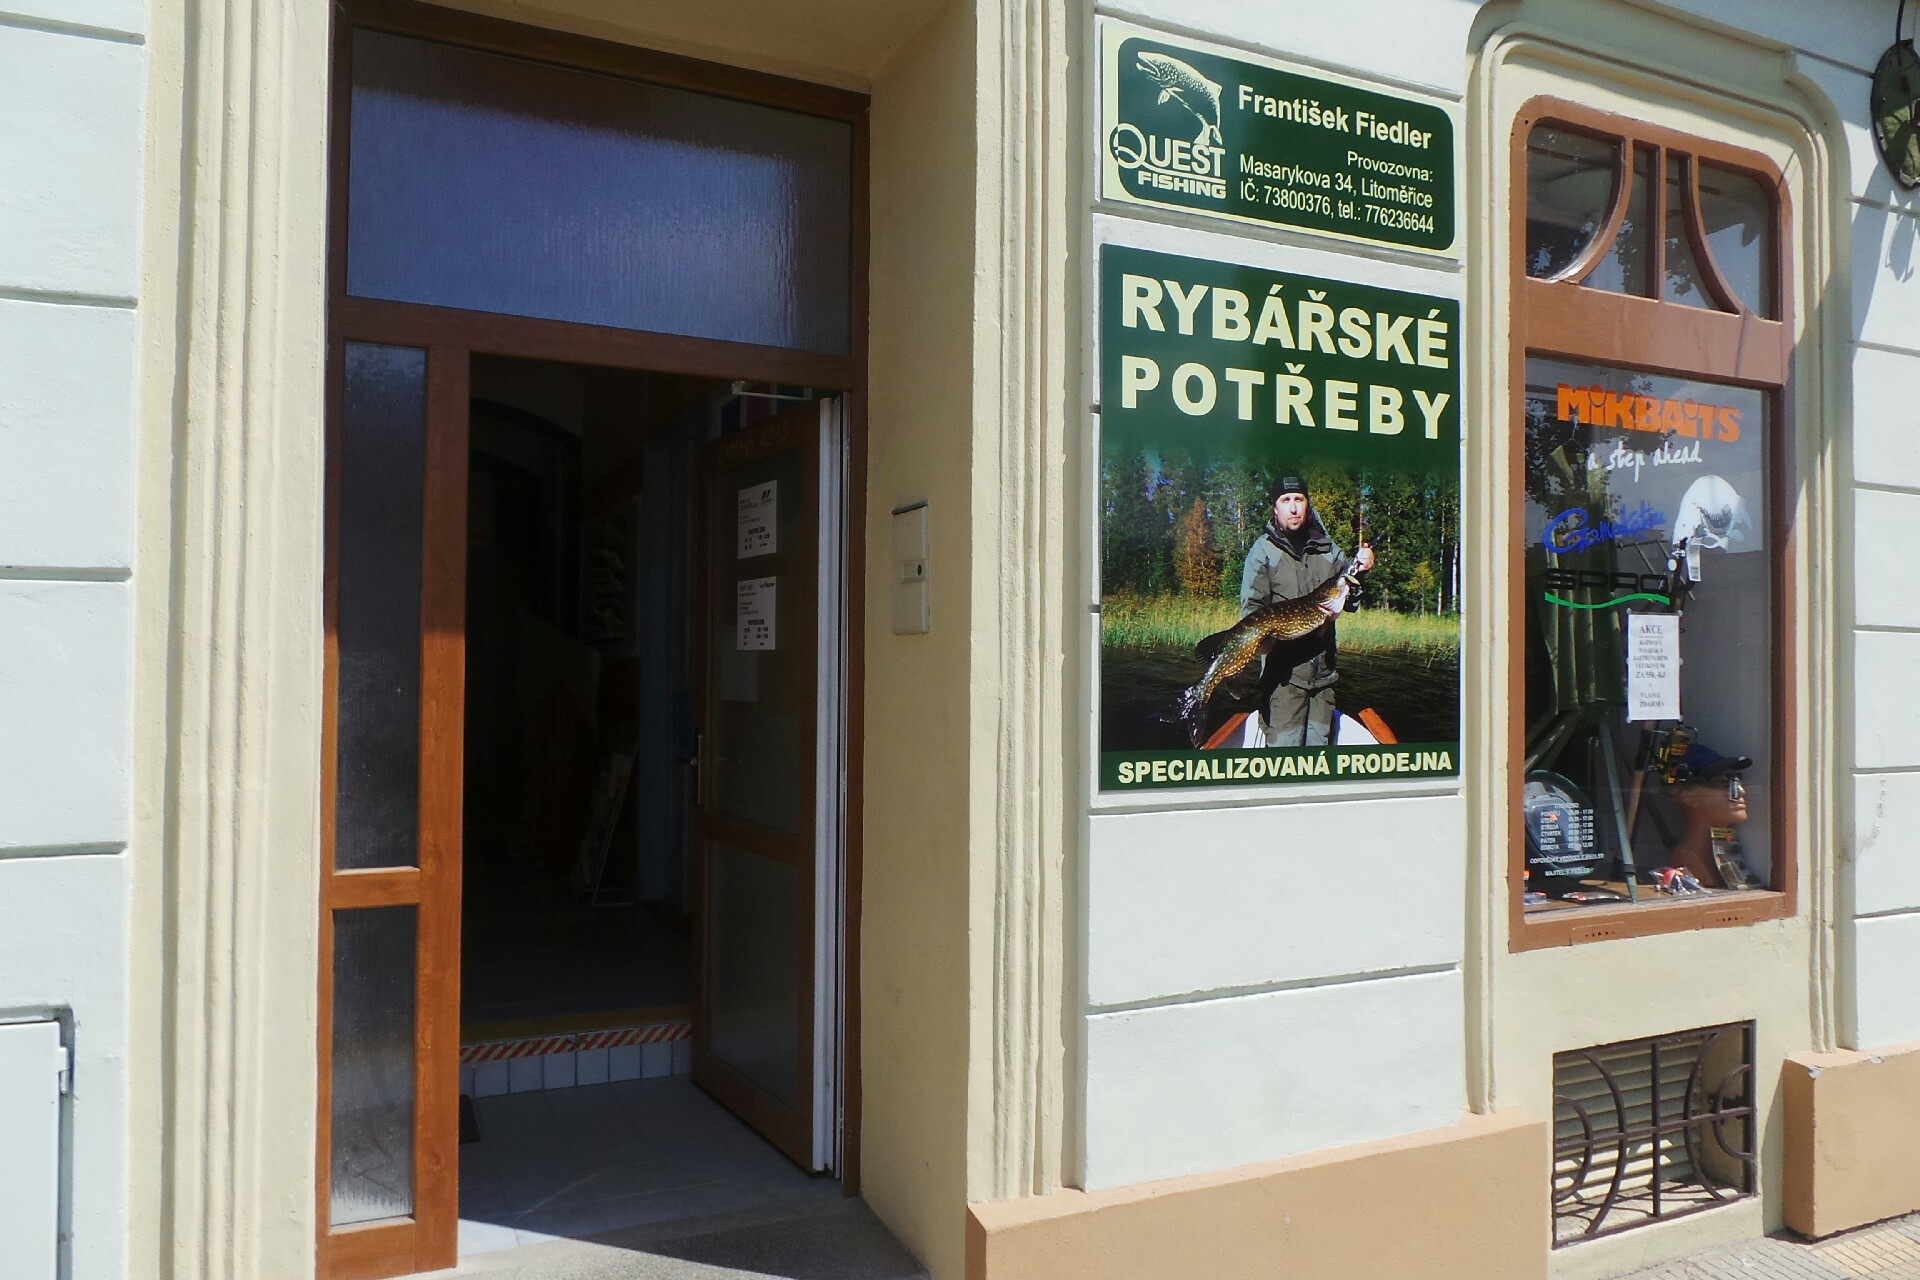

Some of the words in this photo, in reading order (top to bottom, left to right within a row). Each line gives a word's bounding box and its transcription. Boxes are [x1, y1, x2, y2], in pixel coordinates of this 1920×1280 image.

[1238, 83, 1349, 133] František
[1355, 111, 1432, 150] Fiedler
[1109, 122, 1226, 178] QUEST
[1347, 150, 1434, 183] Provozovna:
[1138, 170, 1227, 199] FISHING
[1239, 153, 1331, 190] Masarykova
[1334, 173, 1357, 196] 34,
[1361, 177, 1433, 209] Litoměřice
[1239, 179, 1260, 203] IČ:
[1263, 184, 1334, 219] 73800376,
[1337, 198, 1362, 222] tel.:
[1364, 204, 1435, 234] 776236644
[1122, 273, 1449, 370] RYBÁŘSKÉ
[1121, 354, 1451, 440] POTŘEBY
[1587, 456, 1599, 471] a
[1606, 440, 1645, 483] step
[1653, 440, 1703, 466] ahead
[1639, 624, 1663, 635] AKCE
[1117, 751, 1330, 784] SPECIALIZOVANÁ
[1336, 751, 1453, 775] PRODEJNA
